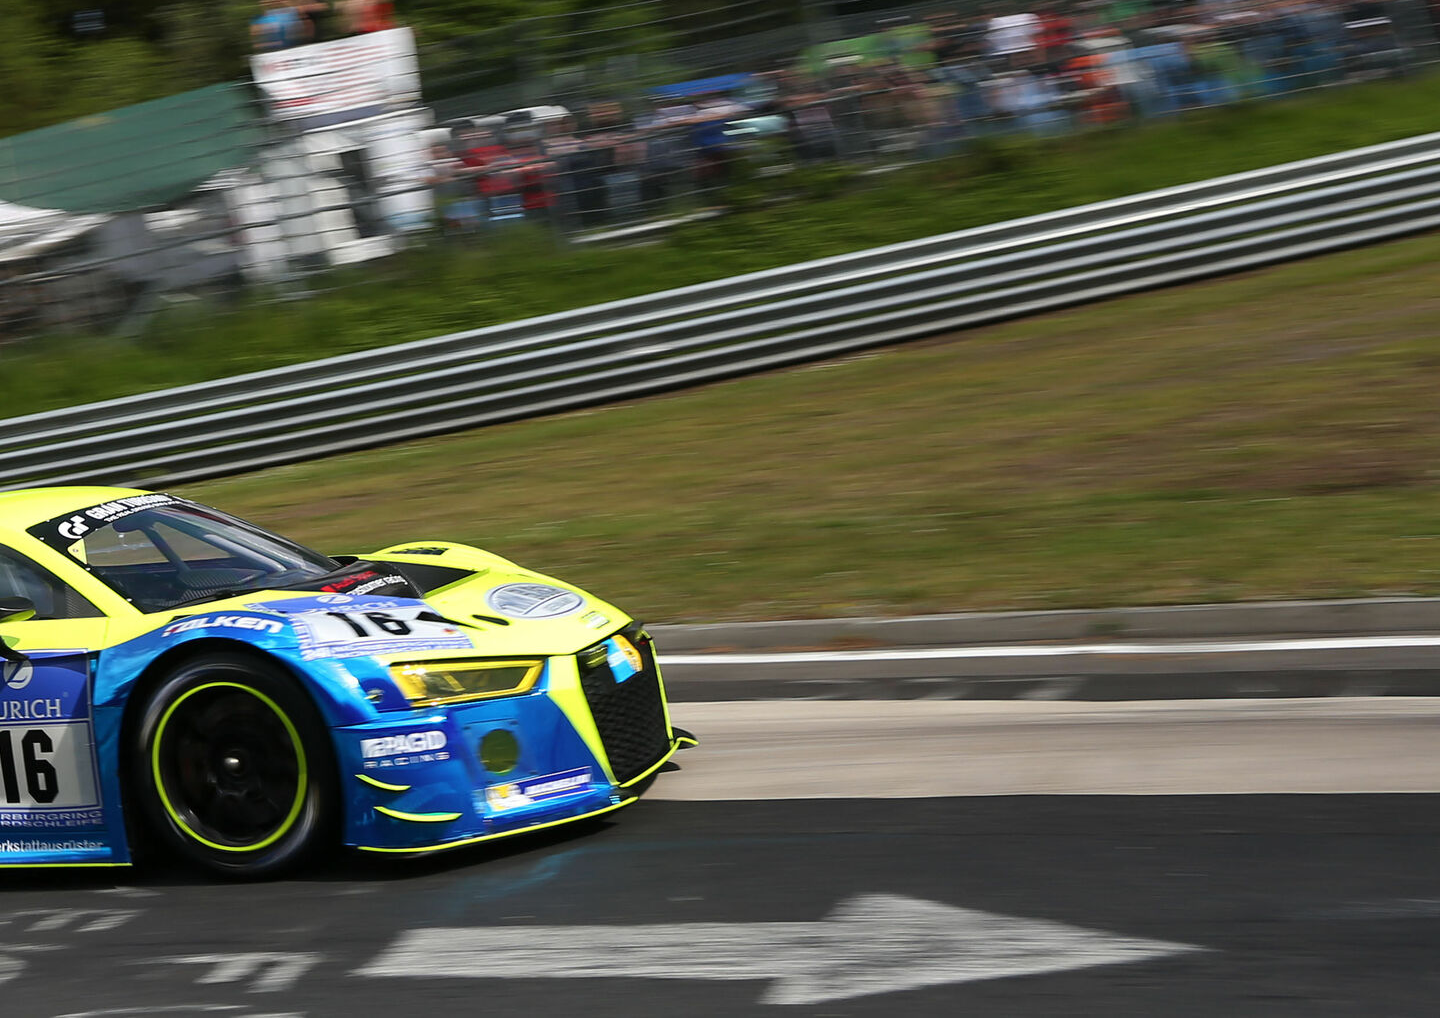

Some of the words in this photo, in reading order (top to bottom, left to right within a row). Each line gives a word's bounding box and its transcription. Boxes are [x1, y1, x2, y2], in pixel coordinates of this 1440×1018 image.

[161, 615, 285, 638] FALKEN
[326, 611, 412, 638] 16
[363, 752, 450, 769] RACING
